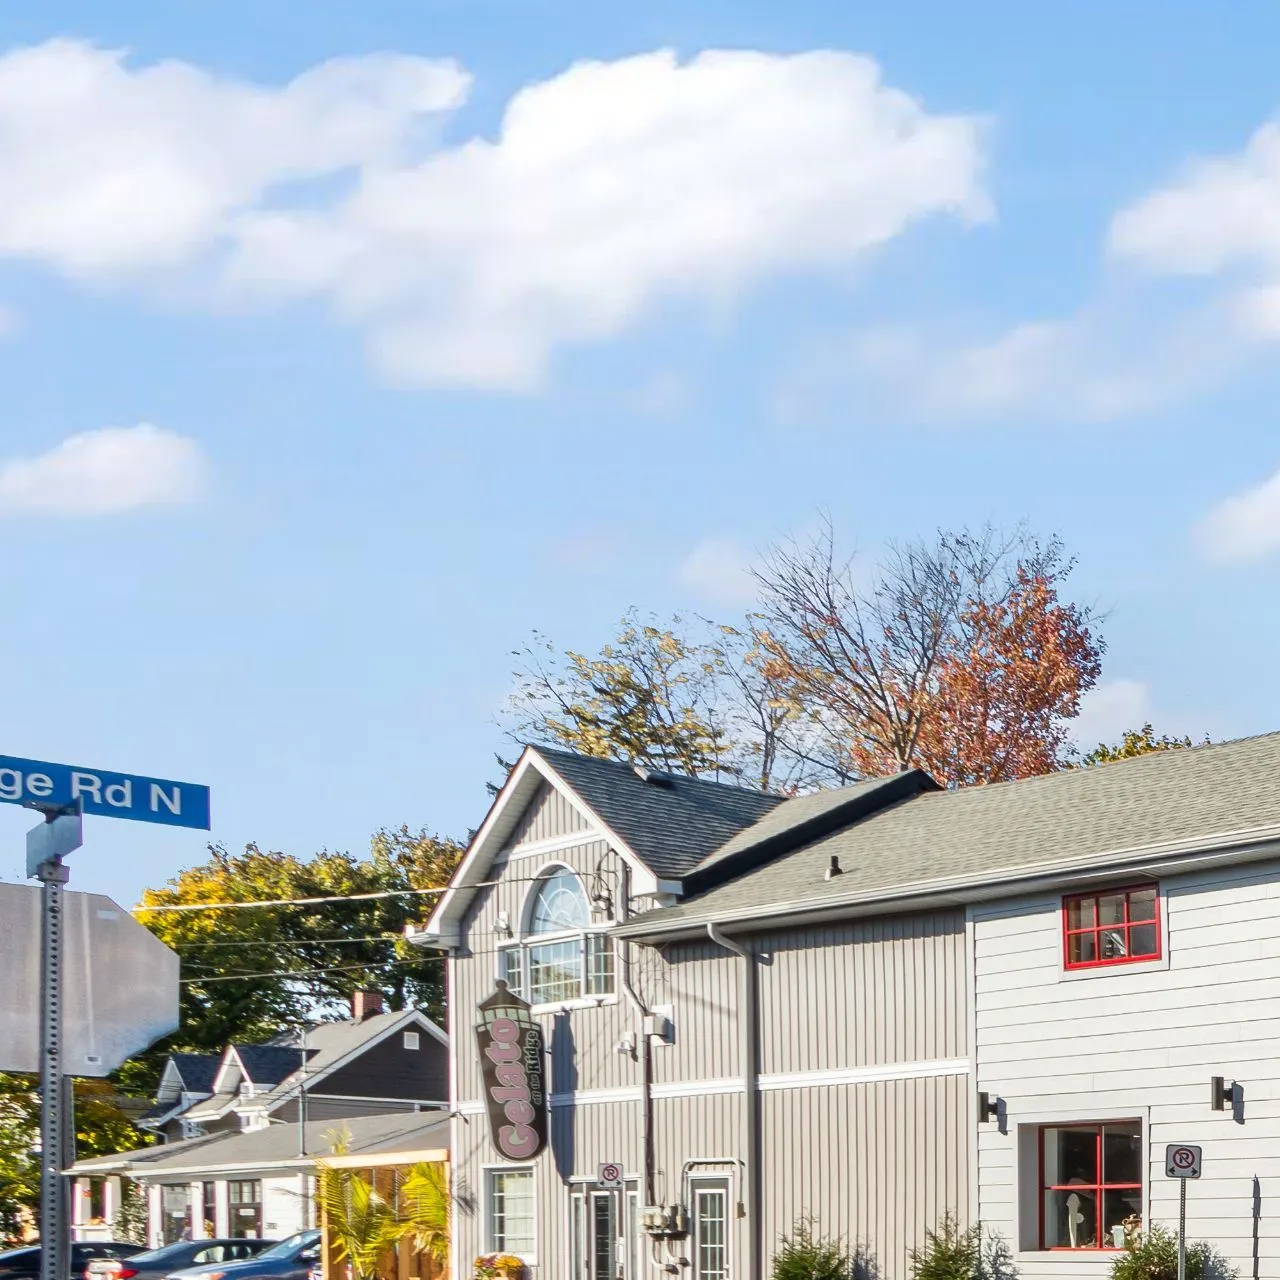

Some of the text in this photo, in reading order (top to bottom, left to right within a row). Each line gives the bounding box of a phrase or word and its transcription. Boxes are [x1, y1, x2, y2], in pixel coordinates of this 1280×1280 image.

[71, 771, 133, 808] Rd
[151, 783, 182, 815] N
[524, 1030, 543, 1074] Ridge
[484, 1017, 540, 1158] Gelato
